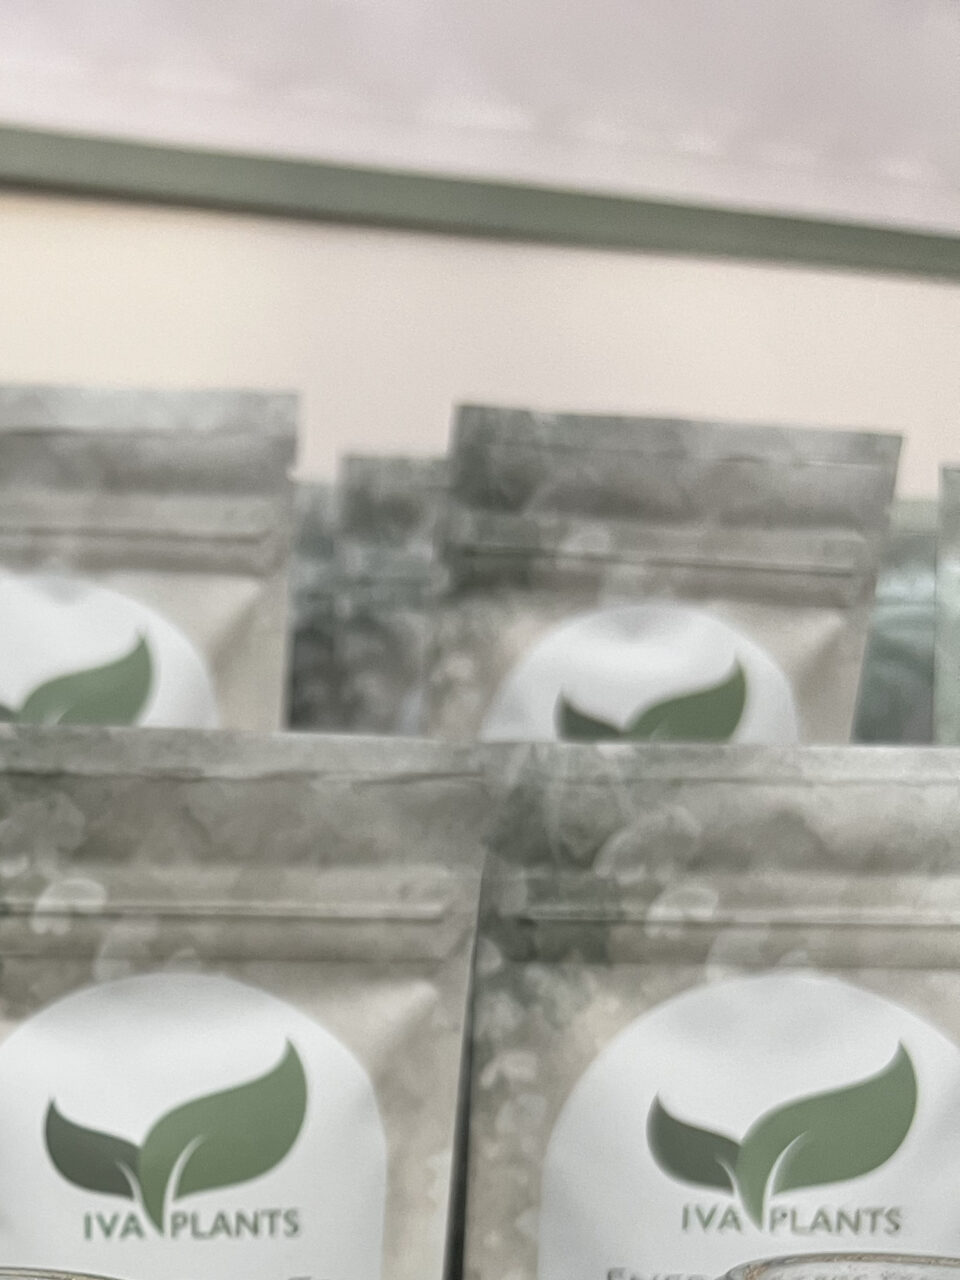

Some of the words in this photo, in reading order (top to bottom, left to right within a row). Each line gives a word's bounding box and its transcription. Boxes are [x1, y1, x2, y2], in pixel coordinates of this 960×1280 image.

[83, 1211, 145, 1239] IVA
[170, 1208, 300, 1240] PLANTS
[681, 1205, 741, 1232] IVA
[769, 1206, 903, 1237] PLANTS
